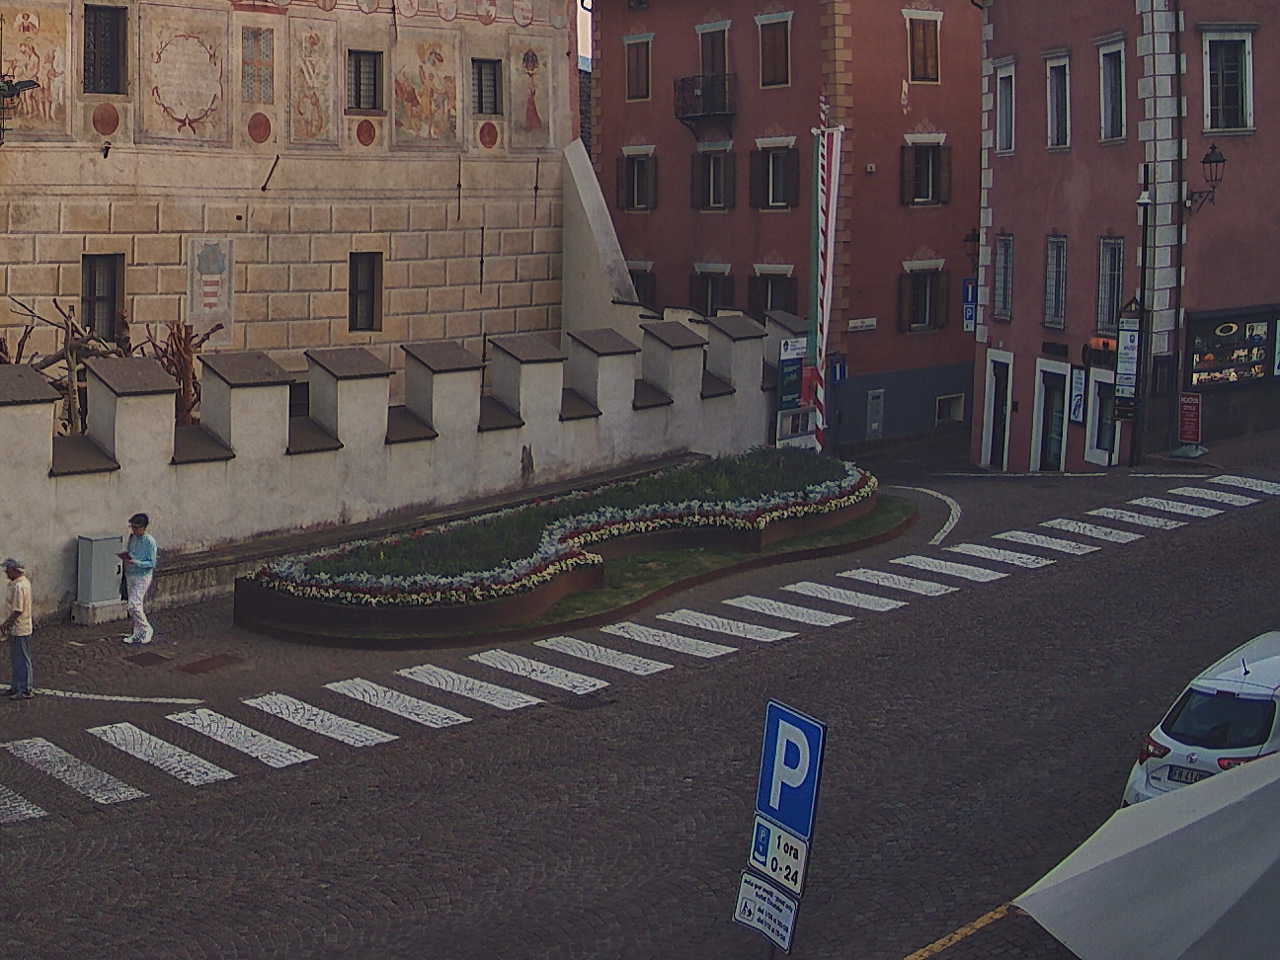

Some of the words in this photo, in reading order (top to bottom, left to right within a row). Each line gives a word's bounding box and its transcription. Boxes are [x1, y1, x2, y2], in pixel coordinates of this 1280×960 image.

[770, 719, 810, 810] P
[776, 835, 782, 849] 1
[783, 841, 799, 860] ora
